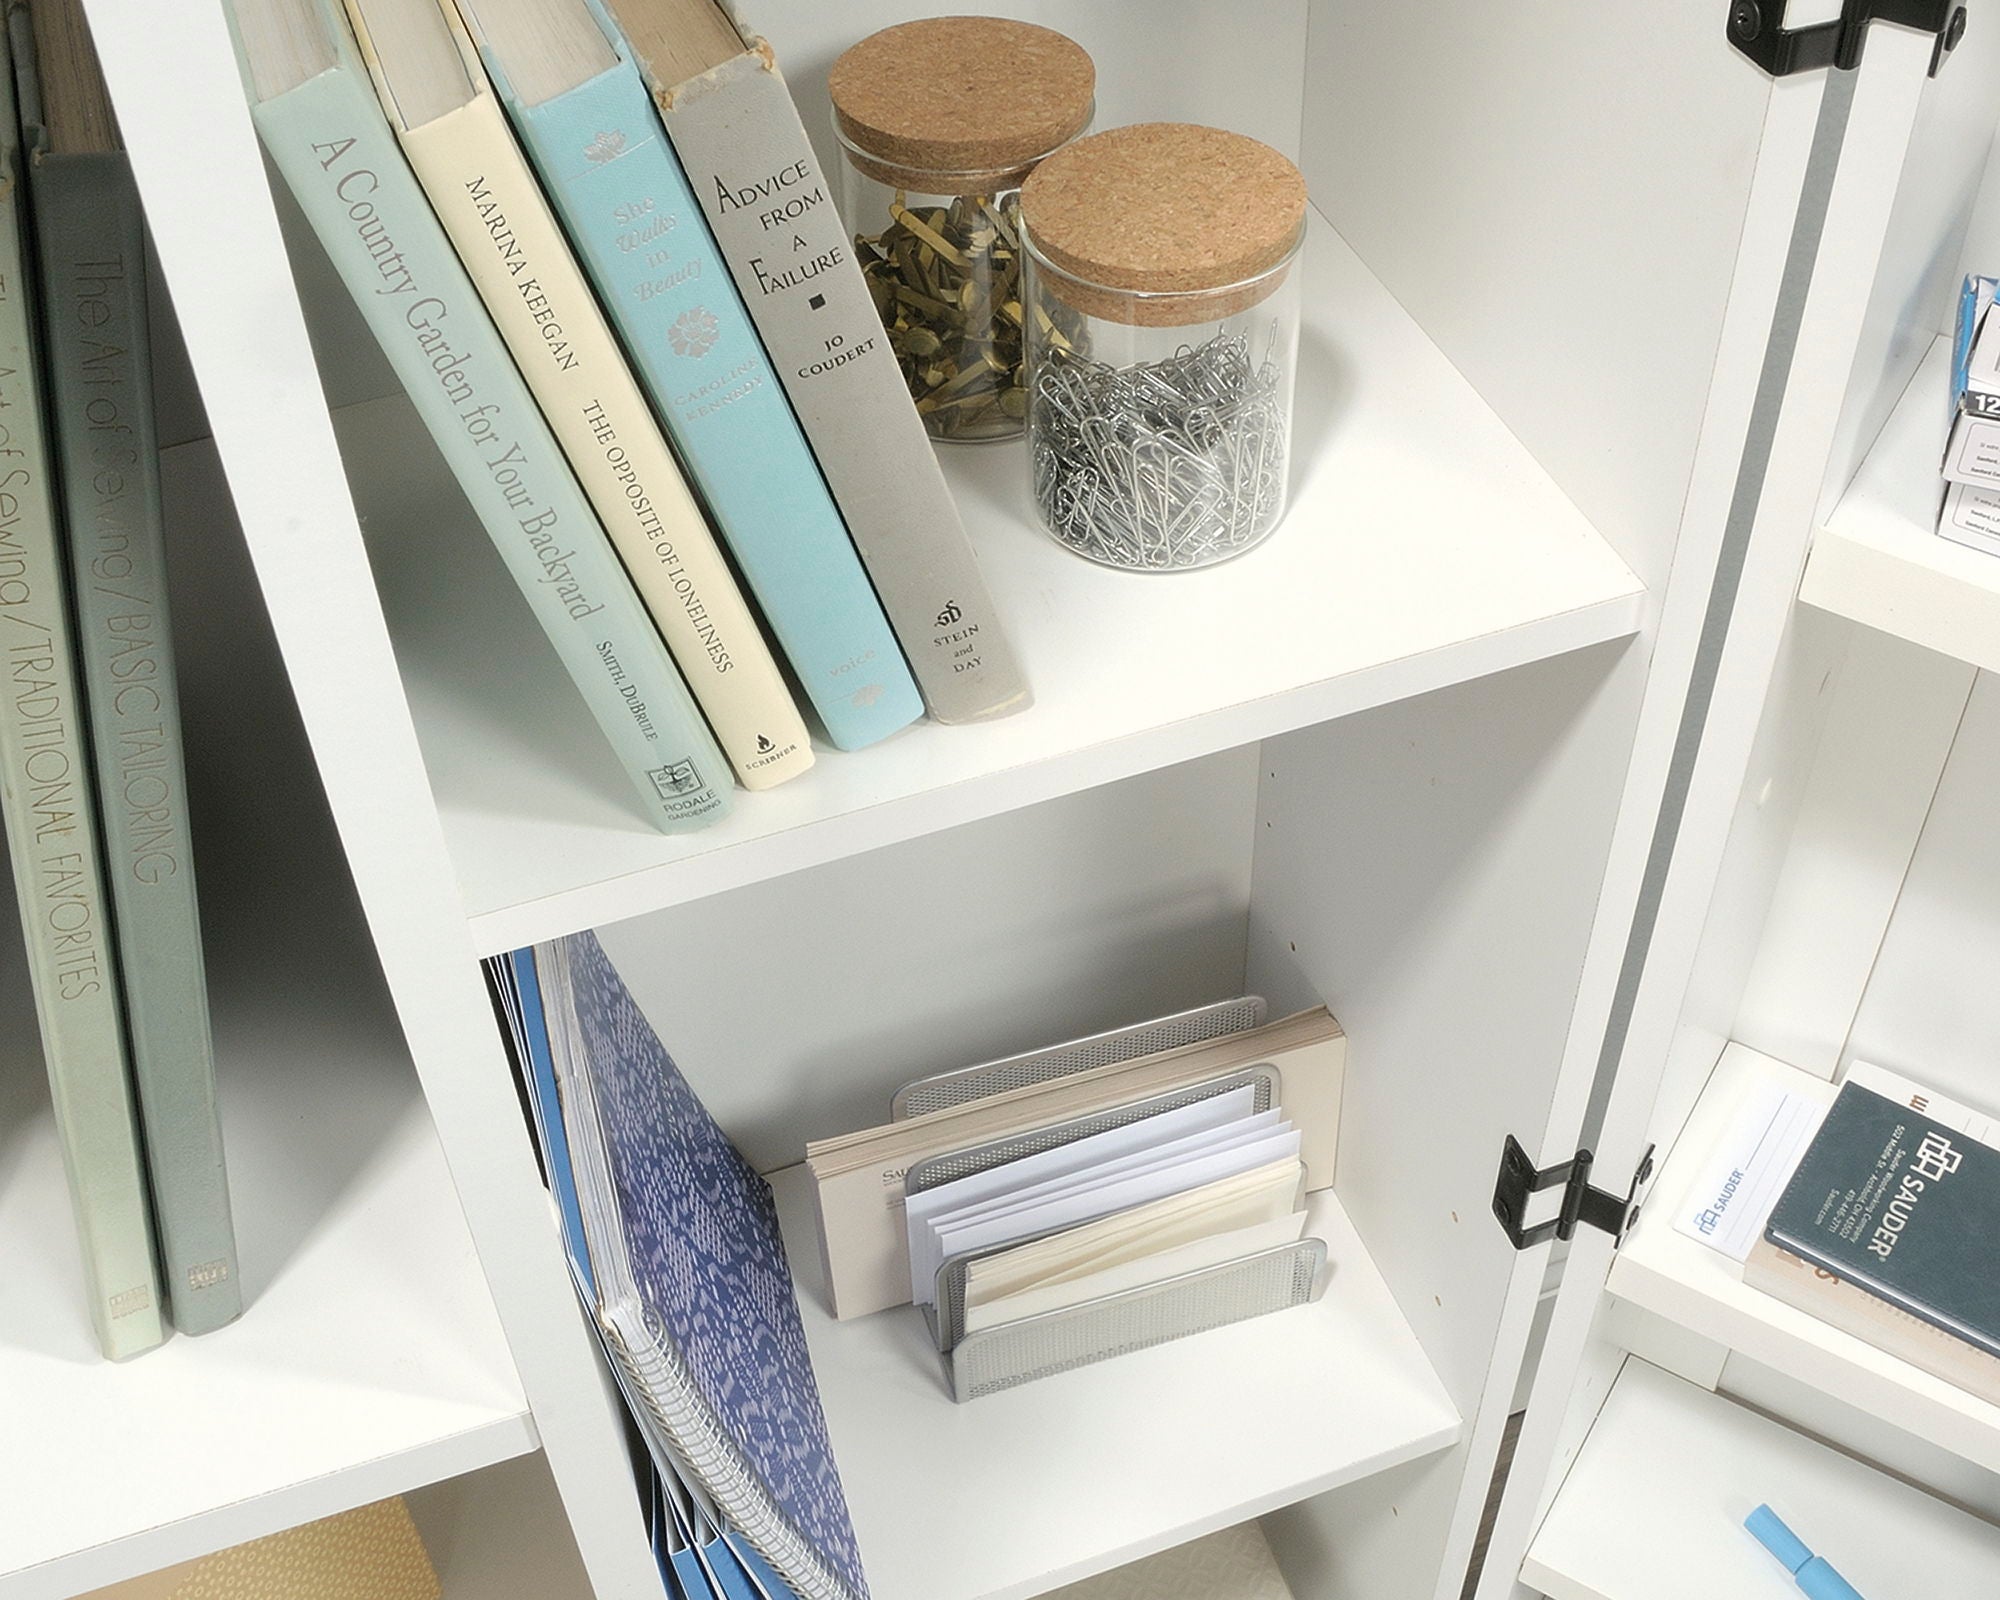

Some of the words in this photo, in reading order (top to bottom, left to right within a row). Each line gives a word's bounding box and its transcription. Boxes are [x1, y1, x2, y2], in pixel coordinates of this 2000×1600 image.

[713, 159, 810, 214] ADVICE
[613, 197, 654, 226] She
[759, 187, 824, 231] FROM
[645, 250, 672, 269] in
[792, 235, 807, 252] A
[75, 254, 124, 327] The
[465, 175, 527, 277] MARINA
[518, 278, 580, 373] KEEGAN
[633, 258, 701, 301] Beauty
[749, 247, 844, 295] FAILURE
[80, 340, 127, 385] Art
[797, 338, 875, 379] COUDERT
[824, 335, 844, 352] JO
[311, 137, 357, 171] A
[336, 169, 418, 295] Country
[405, 297, 472, 405] Garden
[460, 403, 500, 447] for
[486, 441, 534, 510] Your
[518, 506, 605, 621] Backyard
[685, 374, 763, 421] KENNEDY
[86, 398, 133, 433] of
[583, 399, 616, 445] THE
[606, 446, 665, 541] OPPOSITE
[655, 541, 680, 565] OF
[668, 568, 734, 674] LONELINESS
[933, 624, 979, 647] STEIN
[953, 643, 974, 658] and
[107, 613, 160, 716] BASIC
[828, 650, 876, 677] voice
[952, 656, 982, 673] DAY
[8, 637, 76, 844] TRADITIONAL
[745, 744, 797, 770] SCRIBNER
[119, 722, 176, 885] TAILORING
[663, 789, 716, 812] RODALE
[668, 800, 721, 821] GARDENING
[41, 853, 100, 1000] FAVORITES
[1849, 1213, 1872, 1243] Company
